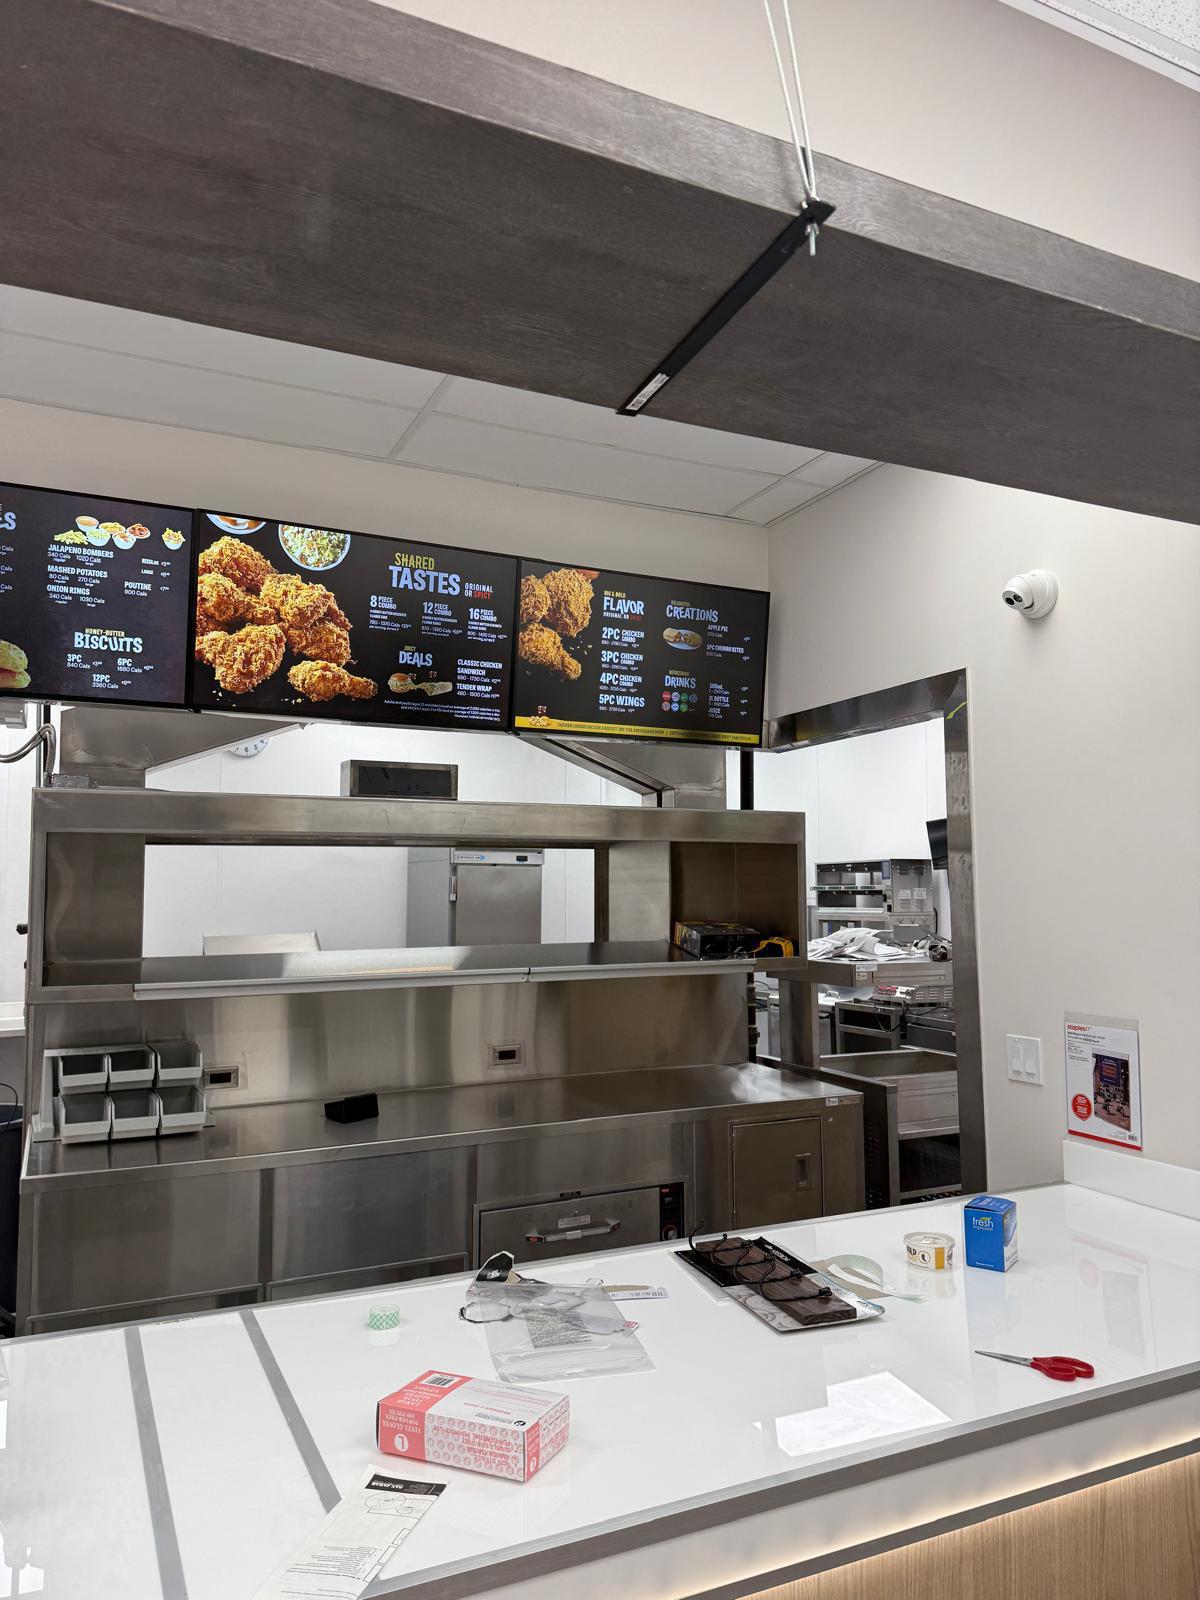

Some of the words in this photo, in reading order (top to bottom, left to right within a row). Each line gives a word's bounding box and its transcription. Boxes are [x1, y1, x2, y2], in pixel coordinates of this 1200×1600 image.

[48, 544, 81, 554] JALAPENO
[83, 548, 113, 558] BOMBERS
[395, 552, 435, 570] SHARED
[47, 565, 75, 574] MASHED
[76, 568, 107, 578] POTATOES
[125, 581, 151, 590] POUTINE
[389, 565, 460, 595] TASTES
[47, 585, 68, 593] ONION
[70, 586, 90, 595] RINGS
[464, 582, 493, 592] ORIGINAL
[370, 595, 377, 607] 8
[474, 591, 491, 600] SPICY
[423, 601, 433, 614] 12
[603, 596, 644, 615] FLAVOR
[469, 608, 480, 620] 16
[603, 611, 622, 619] ORIGINAL
[666, 604, 718, 622] CREATIONS
[85, 628, 125, 637] HONEY-BUTTER
[602, 626, 620, 640] 2PC
[622, 629, 644, 638] CHICKEN
[74, 632, 142, 653] BISCUITS
[67, 654, 82, 662] 3PC
[117, 658, 132, 666] 6PC
[399, 650, 433, 667] DEALS
[601, 650, 619, 663] 3PC
[621, 652, 643, 661] CHICKEN
[457, 659, 479, 667] CLASSIC
[480, 661, 502, 669] CHICKEN
[457, 667, 486, 676] SANDWICH
[92, 674, 110, 683] 12PC
[600, 672, 618, 685] 4PC
[619, 674, 642, 683] CHICKEN
[665, 675, 696, 688] DRINKS
[456, 683, 476, 691] TENDER
[599, 694, 615, 704] 5PC
[616, 695, 645, 707] WINGS
[973, 1216, 994, 1228] fresh
